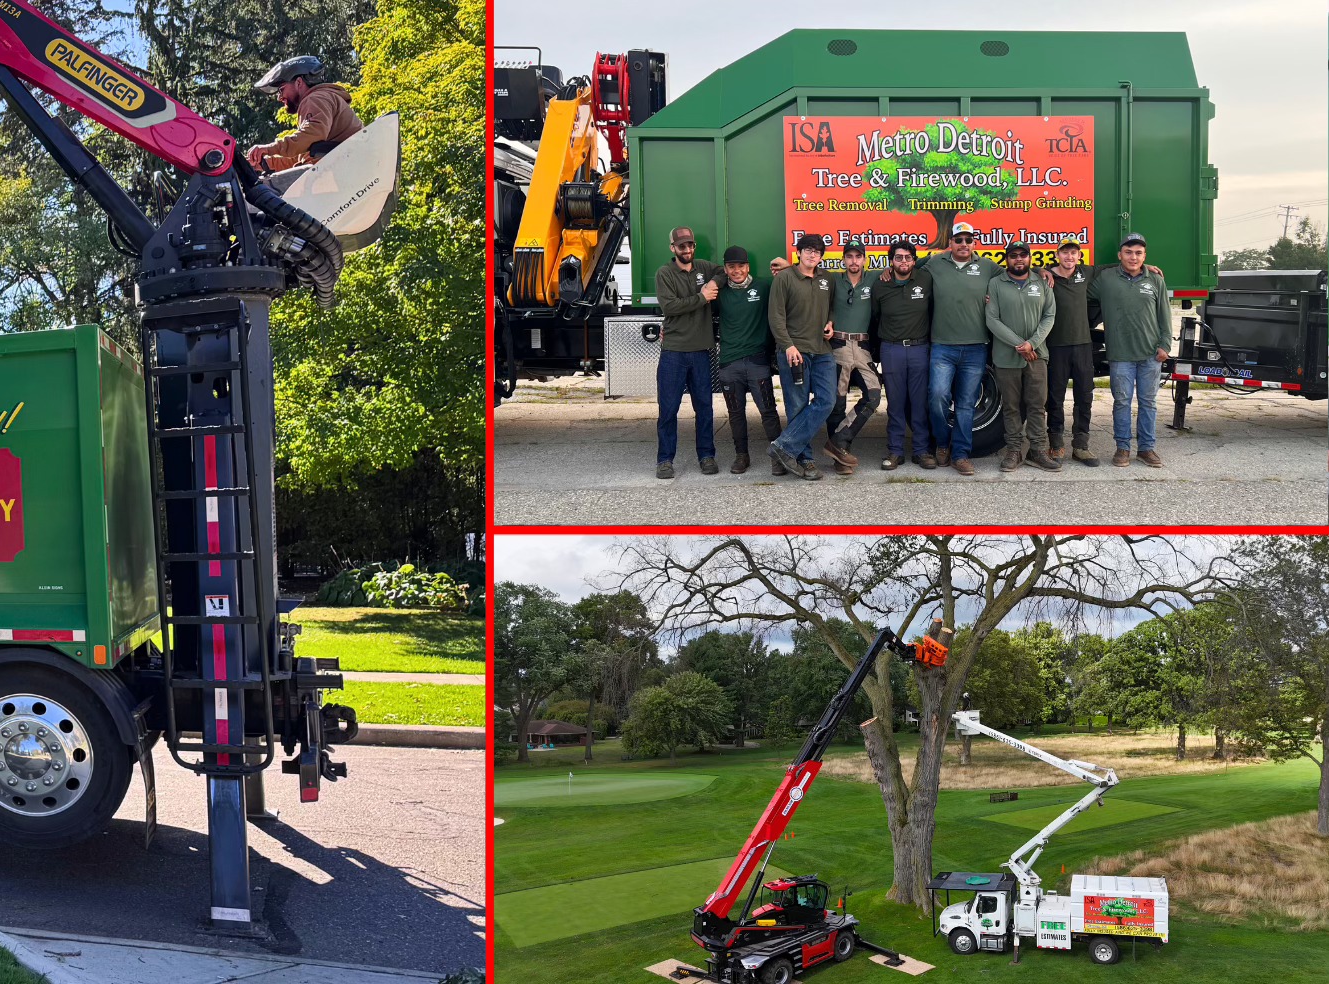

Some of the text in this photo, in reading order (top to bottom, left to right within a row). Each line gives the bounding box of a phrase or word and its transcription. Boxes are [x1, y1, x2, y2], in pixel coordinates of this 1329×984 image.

[50, 43, 139, 106] PALFINGER
[788, 121, 836, 153] ISA
[856, 121, 1025, 167] Metro Detroit
[812, 166, 1069, 190] Tree & Firewood, LLC.
[355, 177, 380, 198] Drive
[793, 199, 888, 212] Tree Removal
[908, 198, 975, 213] Trimming
[991, 195, 1093, 213] Stump Grinding
[792, 229, 928, 247] Fe Estimates
[1198, 365, 1223, 375] LOAD
[1040, 921, 1066, 930] FREE
[1041, 933, 1067, 941] ESTIMATES
